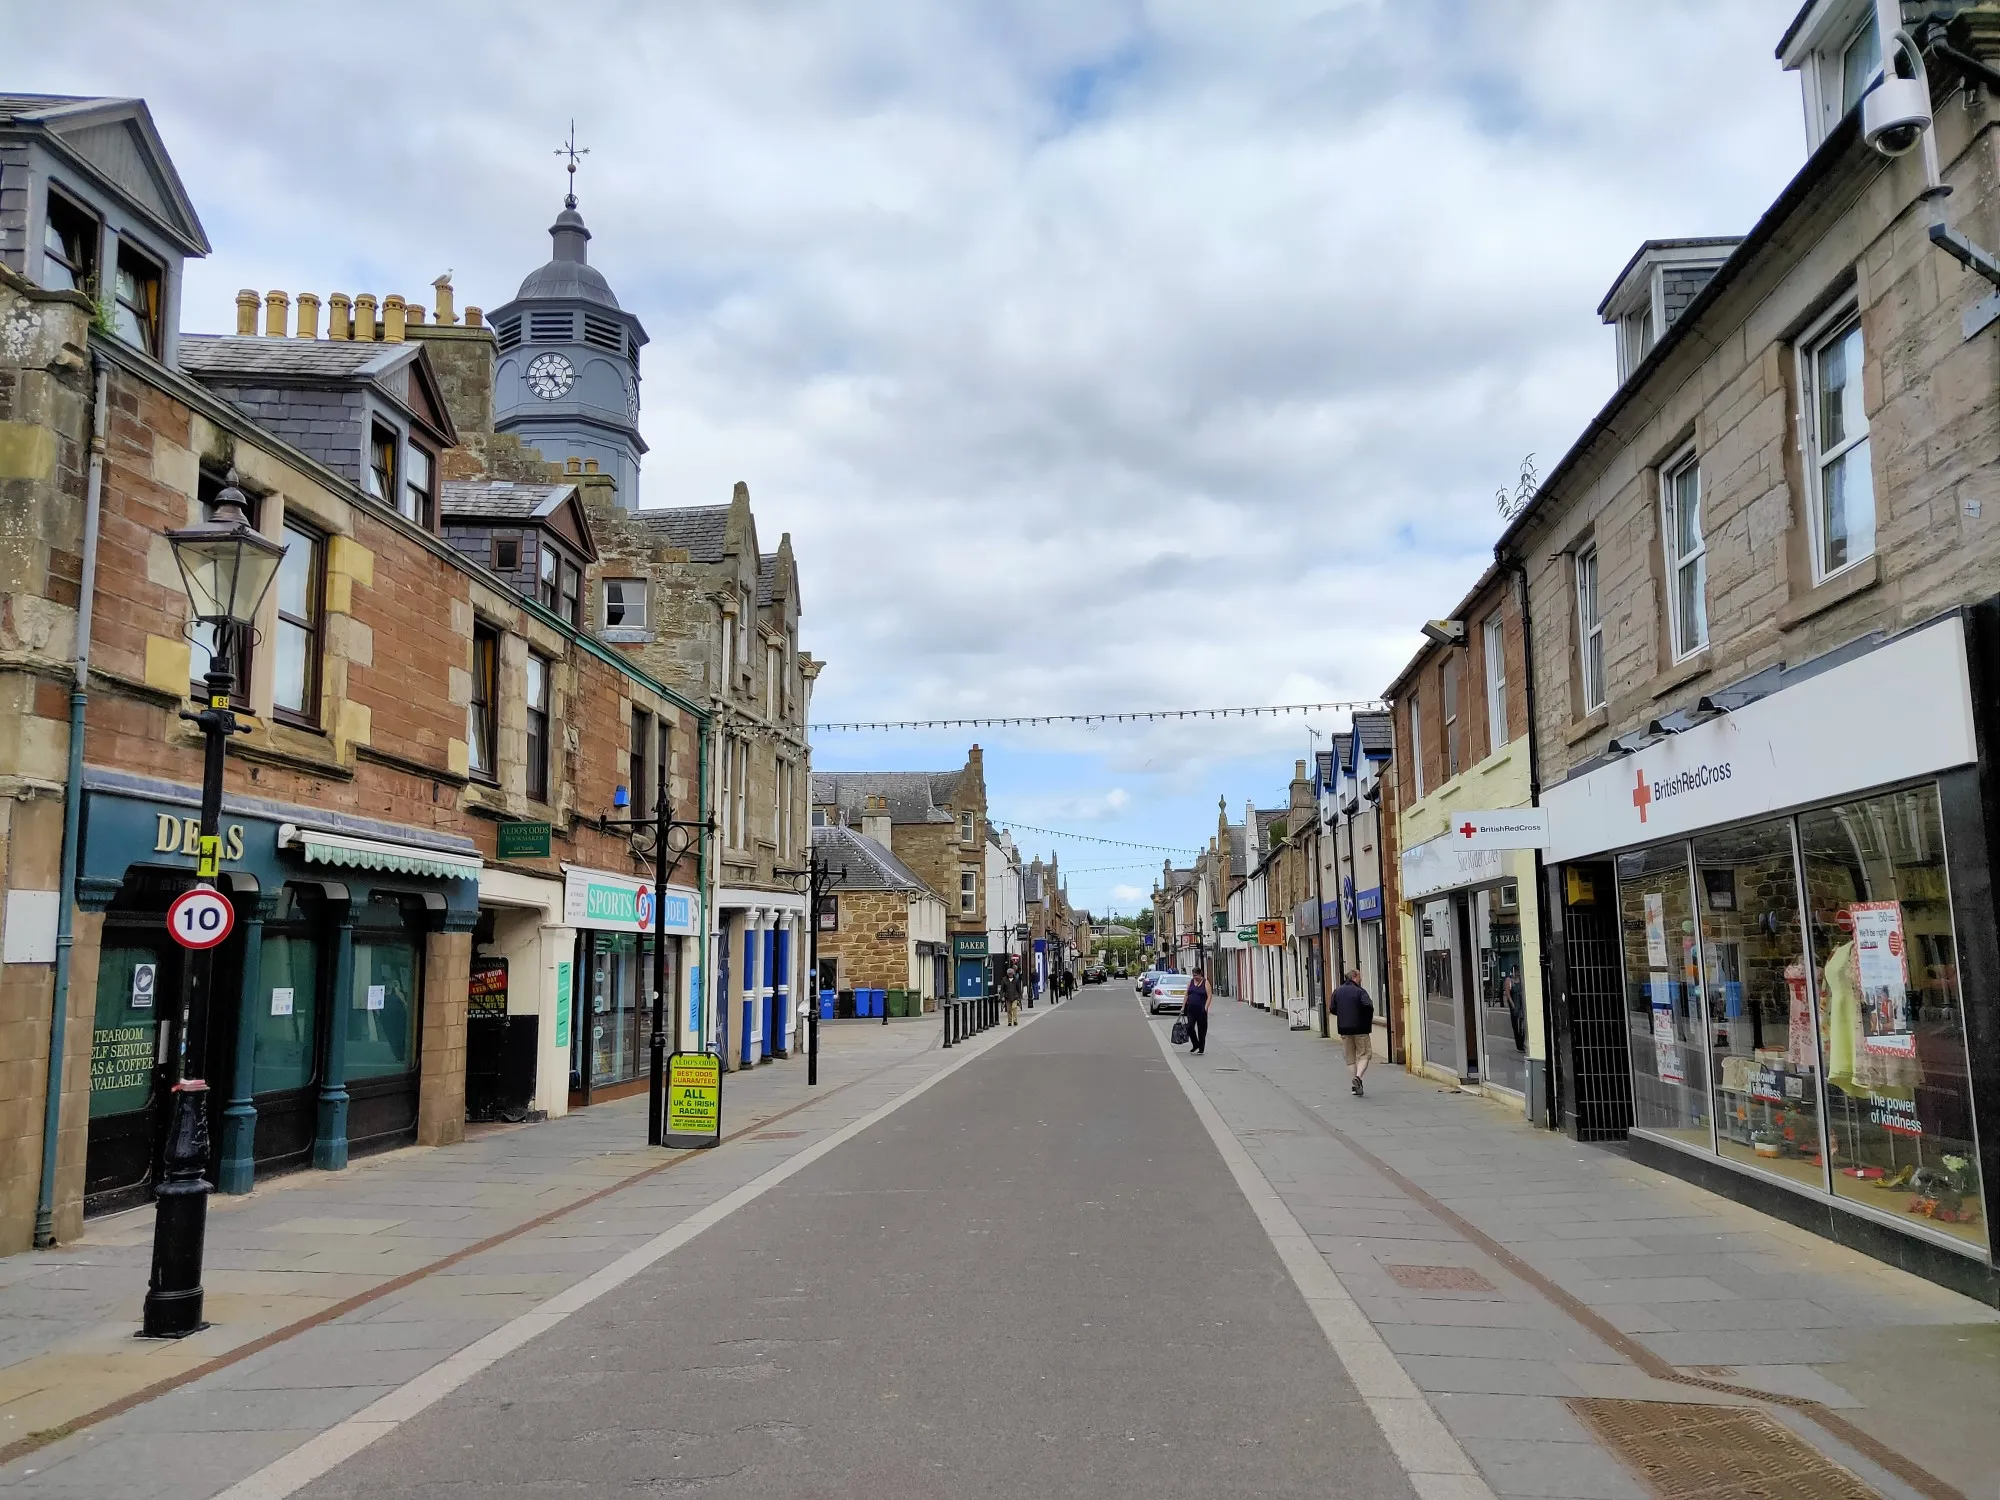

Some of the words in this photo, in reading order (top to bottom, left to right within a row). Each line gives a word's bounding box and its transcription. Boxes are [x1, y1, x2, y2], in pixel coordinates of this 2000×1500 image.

[1654, 762, 1732, 801] BritishRedCross
[154, 812, 244, 861] DES
[528, 826, 549, 835] ODDS
[1480, 824, 1541, 833] BritishRedCross
[588, 888, 632, 918] SPORTS
[640, 896, 646, 917] &
[184, 907, 220, 931] 10
[960, 942, 985, 950] BAKER
[95, 1027, 144, 1043] TEAROOM
[91, 1045, 110, 1060] ELF
[110, 1042, 153, 1058] SERVICE
[106, 1060, 115, 1074] &
[116, 1056, 155, 1073] COFFEE
[90, 1072, 144, 1092] AVAILABLE
[673, 1077, 717, 1085] GUARANTEED
[684, 1088, 706, 1100] ALL
[1870, 1091, 1886, 1107] The
[1886, 1097, 1916, 1113] power
[673, 1099, 684, 1107] UK
[694, 1100, 715, 1108] IRISH
[679, 1107, 709, 1115] RACING
[1870, 1109, 1881, 1124] of
[1881, 1110, 1922, 1133] kindness
